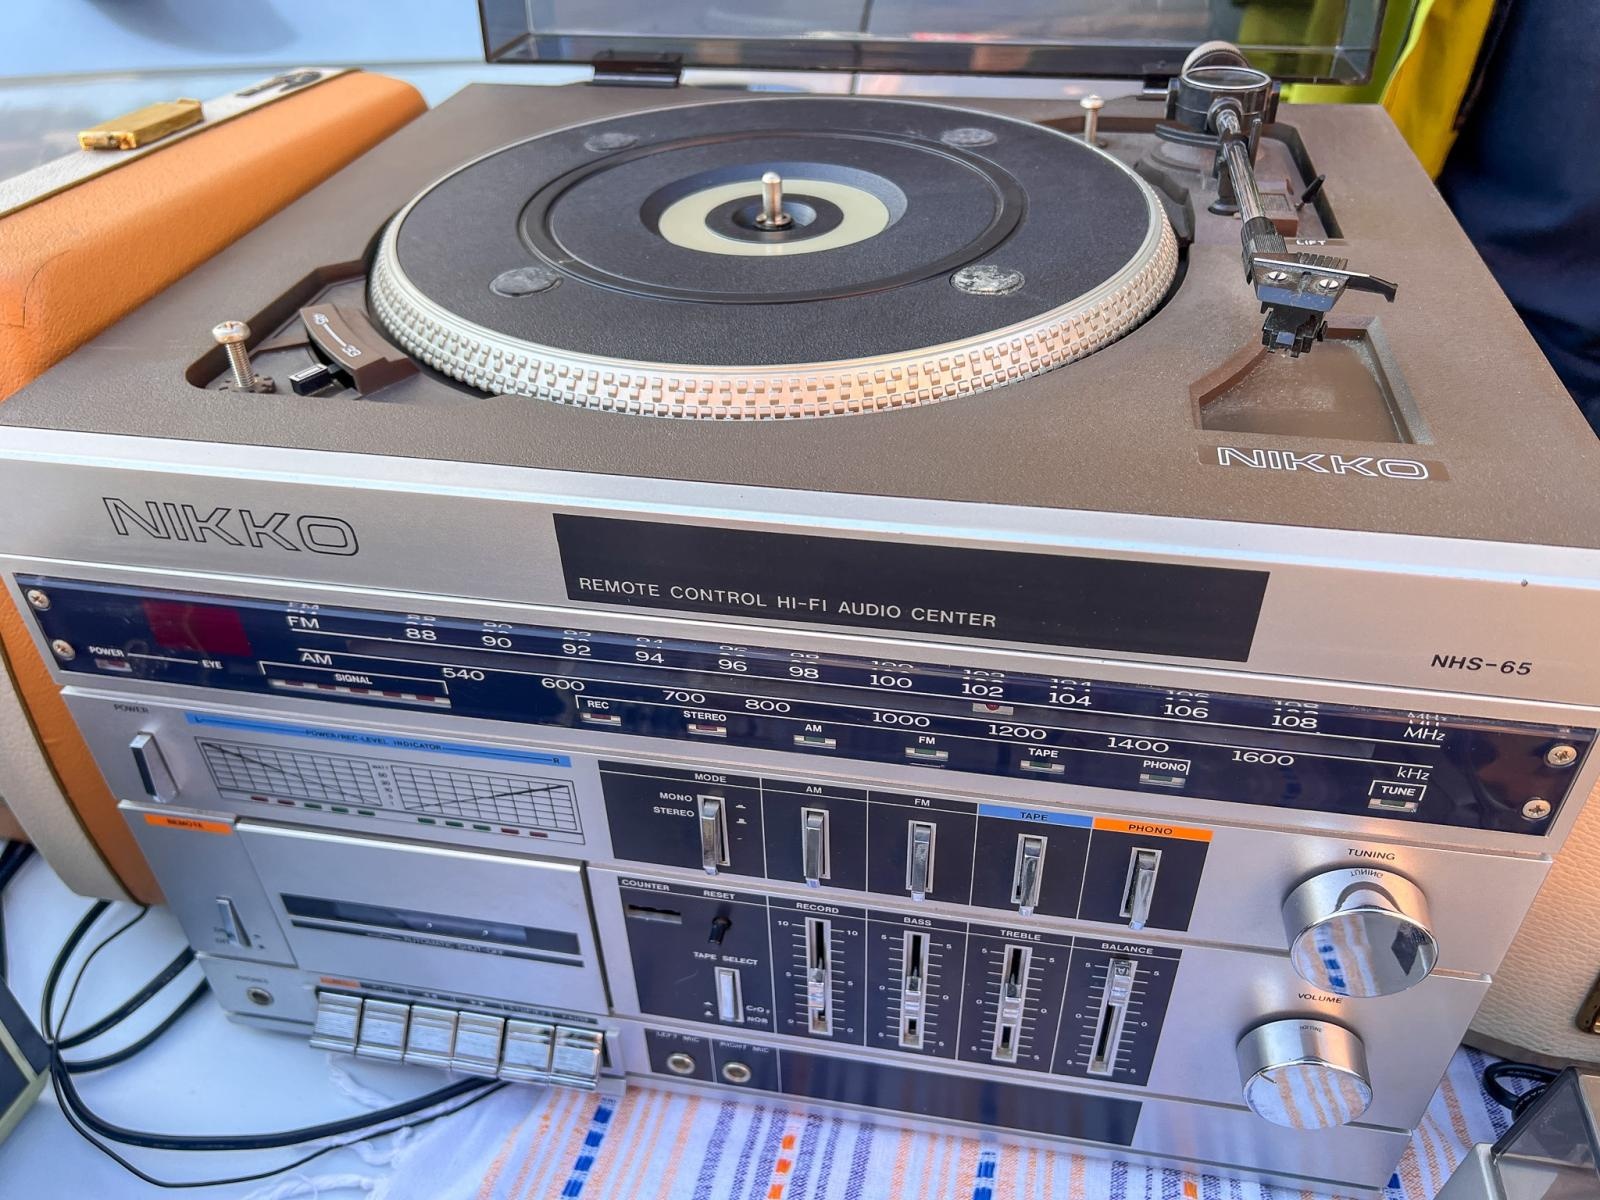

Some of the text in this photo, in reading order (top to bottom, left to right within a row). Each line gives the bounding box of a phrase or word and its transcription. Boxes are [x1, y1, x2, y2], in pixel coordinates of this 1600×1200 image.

[1217, 447, 1429, 480] NIKKO
[102, 497, 359, 556] NIKKO
[579, 577, 996, 628] REMOTE CONTROL HI-FI AUDIO CENTER
[89, 645, 124, 658] POWER
[202, 659, 223, 670] EYE
[1431, 654, 1533, 676] NHS-65
[287, 615, 1446, 741] FM 88 90 92 94 96 98 100 102 104 106 108 MHz
[334, 673, 373, 686] SIGNAL
[113, 704, 150, 714] POWER
[587, 700, 609, 710] REC
[300, 652, 1430, 780] AM 540 600 700 800 1000 1200 1400 1600 kHz
[683, 710, 727, 722] STEREO
[805, 723, 822, 733] AM
[918, 736, 936, 746] FM
[1028, 748, 1059, 758] TAPE
[1143, 760, 1187, 772] PHONO
[694, 773, 727, 784] MODE
[806, 785, 822, 794] AM
[1381, 785, 1416, 797] TUNE
[659, 792, 693, 802] MONO
[914, 799, 930, 807] FM
[653, 806, 695, 818] STEREO
[1020, 811, 1048, 822] TAPE
[1128, 824, 1173, 836] PHONO
[1347, 848, 1396, 861] TUNING
[621, 879, 670, 892] COUNTER
[703, 890, 736, 900] RESET
[796, 902, 840, 914] RECORD
[903, 916, 932, 927] BASS
[1000, 930, 1042, 941] TREBLE
[1101, 942, 1154, 955] BALANCE
[692, 951, 759, 966] TAPE SELECT
[1298, 993, 1343, 1004] VOLUME
